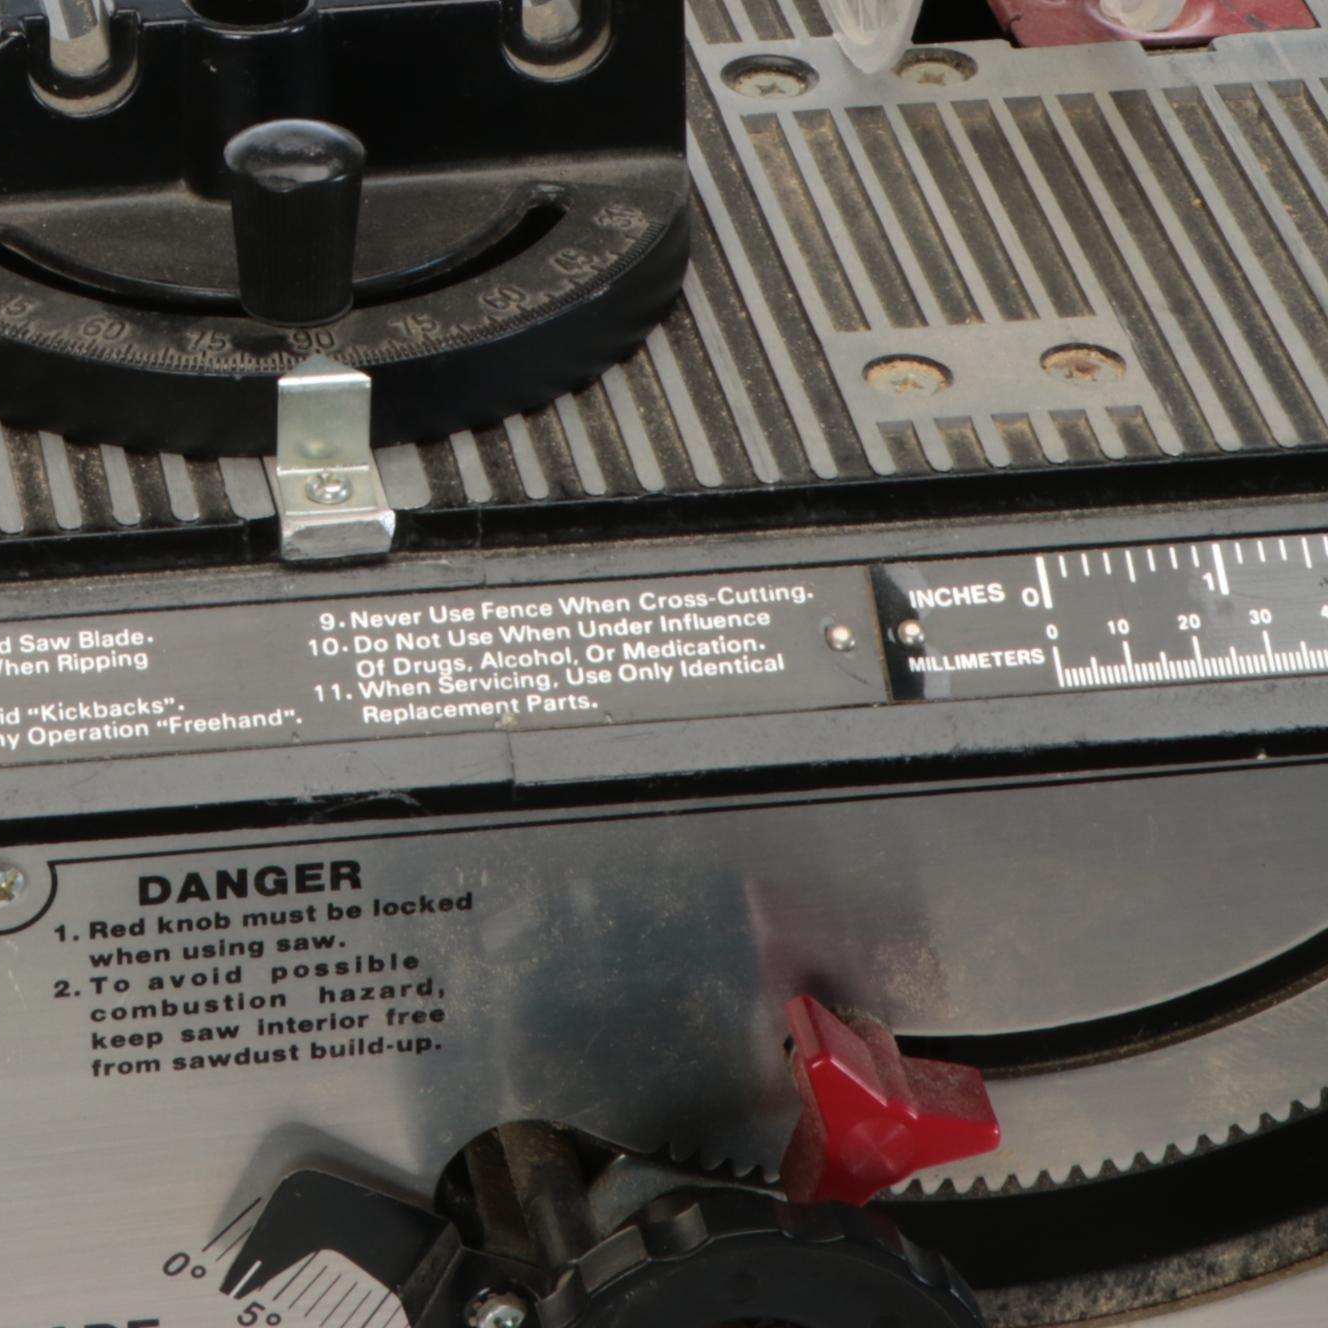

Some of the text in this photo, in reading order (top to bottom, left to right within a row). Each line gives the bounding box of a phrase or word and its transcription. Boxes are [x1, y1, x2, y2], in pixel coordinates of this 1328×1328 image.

[83, 318, 126, 340] 60
[190, 331, 231, 353] 75
[293, 330, 334, 351] 90
[481, 288, 526, 310] 60
[319, 586, 813, 631] 9. Never Use Fence When Cross-Cutting.
[909, 572, 1215, 609] INCHES 0 1
[19, 634, 71, 653] Saw
[79, 629, 153, 649] Blade.
[309, 612, 770, 656] 10. Do Not Use When Under Influence
[1046, 609, 1271, 640] 0 10 20 30
[57, 650, 148, 674] Ripping
[314, 653, 784, 702] 11. When Servicing, Use Only Identical
[356, 635, 765, 678] Of Drugs, Alcohol, Or Medication.
[909, 648, 1045, 672] MILLIMETERS
[362, 694, 598, 725] Replacement Parts.
[27, 721, 149, 747] Operation
[139, 860, 362, 906] DANGER
[54, 891, 473, 942] 1. Red knob must be locked
[89, 935, 345, 967] when using saw.
[54, 952, 420, 998] 2. To avoid possible
[90, 976, 445, 1022] combustion hazard,
[92, 1008, 445, 1050] keep saw interior free
[91, 1036, 443, 1077] from sawdust build-up.
